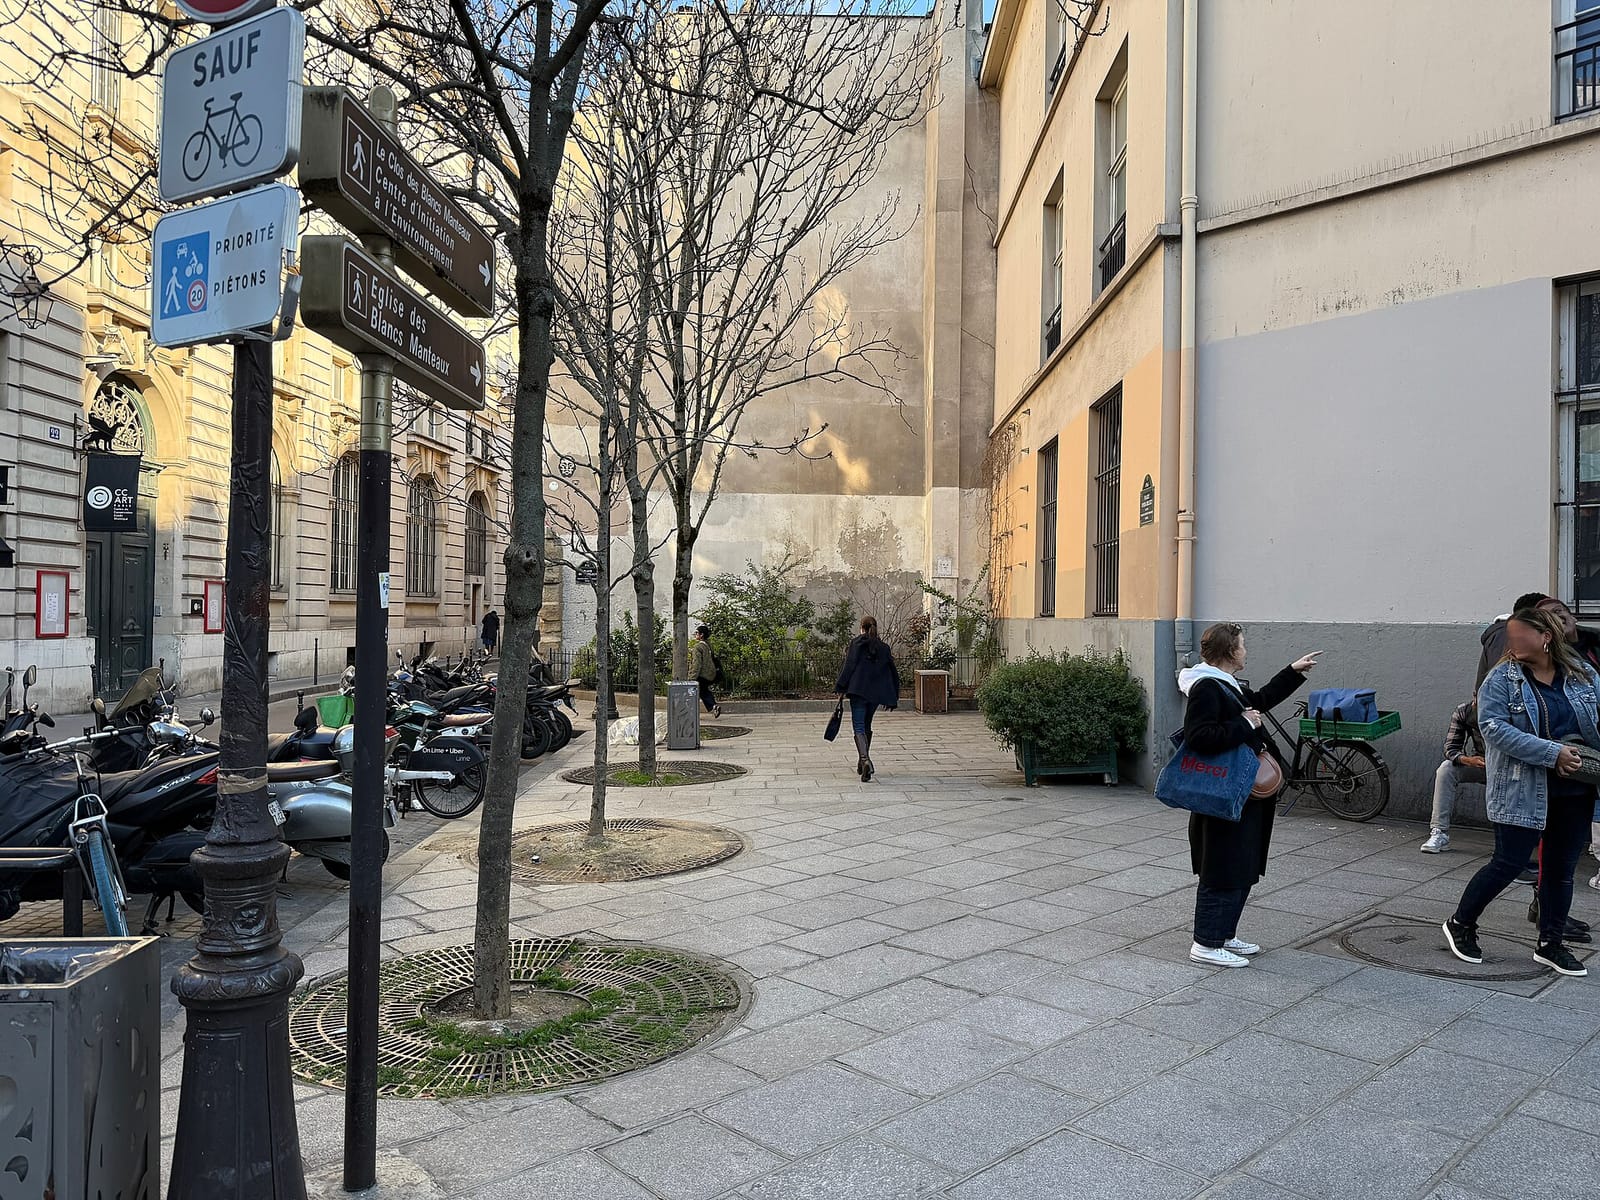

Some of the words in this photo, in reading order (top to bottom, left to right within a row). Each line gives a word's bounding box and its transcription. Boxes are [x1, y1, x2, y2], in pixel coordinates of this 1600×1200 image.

[193, 29, 261, 87] SAUF
[375, 166, 407, 207] Centre
[410, 201, 455, 250] d'Initiation
[376, 139, 385, 161] Le
[388, 152, 404, 180] Clos
[407, 172, 419, 194] des
[421, 183, 442, 216] Blancs
[443, 205, 471, 244] Manteaux
[215, 222, 275, 255] PRIORITÉ
[374, 191, 380, 210] à
[384, 201, 453, 272] l'Environnement
[191, 289, 202, 302] 20
[213, 269, 266, 297] PIÉTONS
[371, 275, 404, 319] Eglise
[410, 307, 426, 334] des
[370, 306, 403, 347] Blancs
[409, 333, 450, 377] Manteaux
[50, 428, 59, 438] 22
[1181, 755, 1229, 778] Merci
